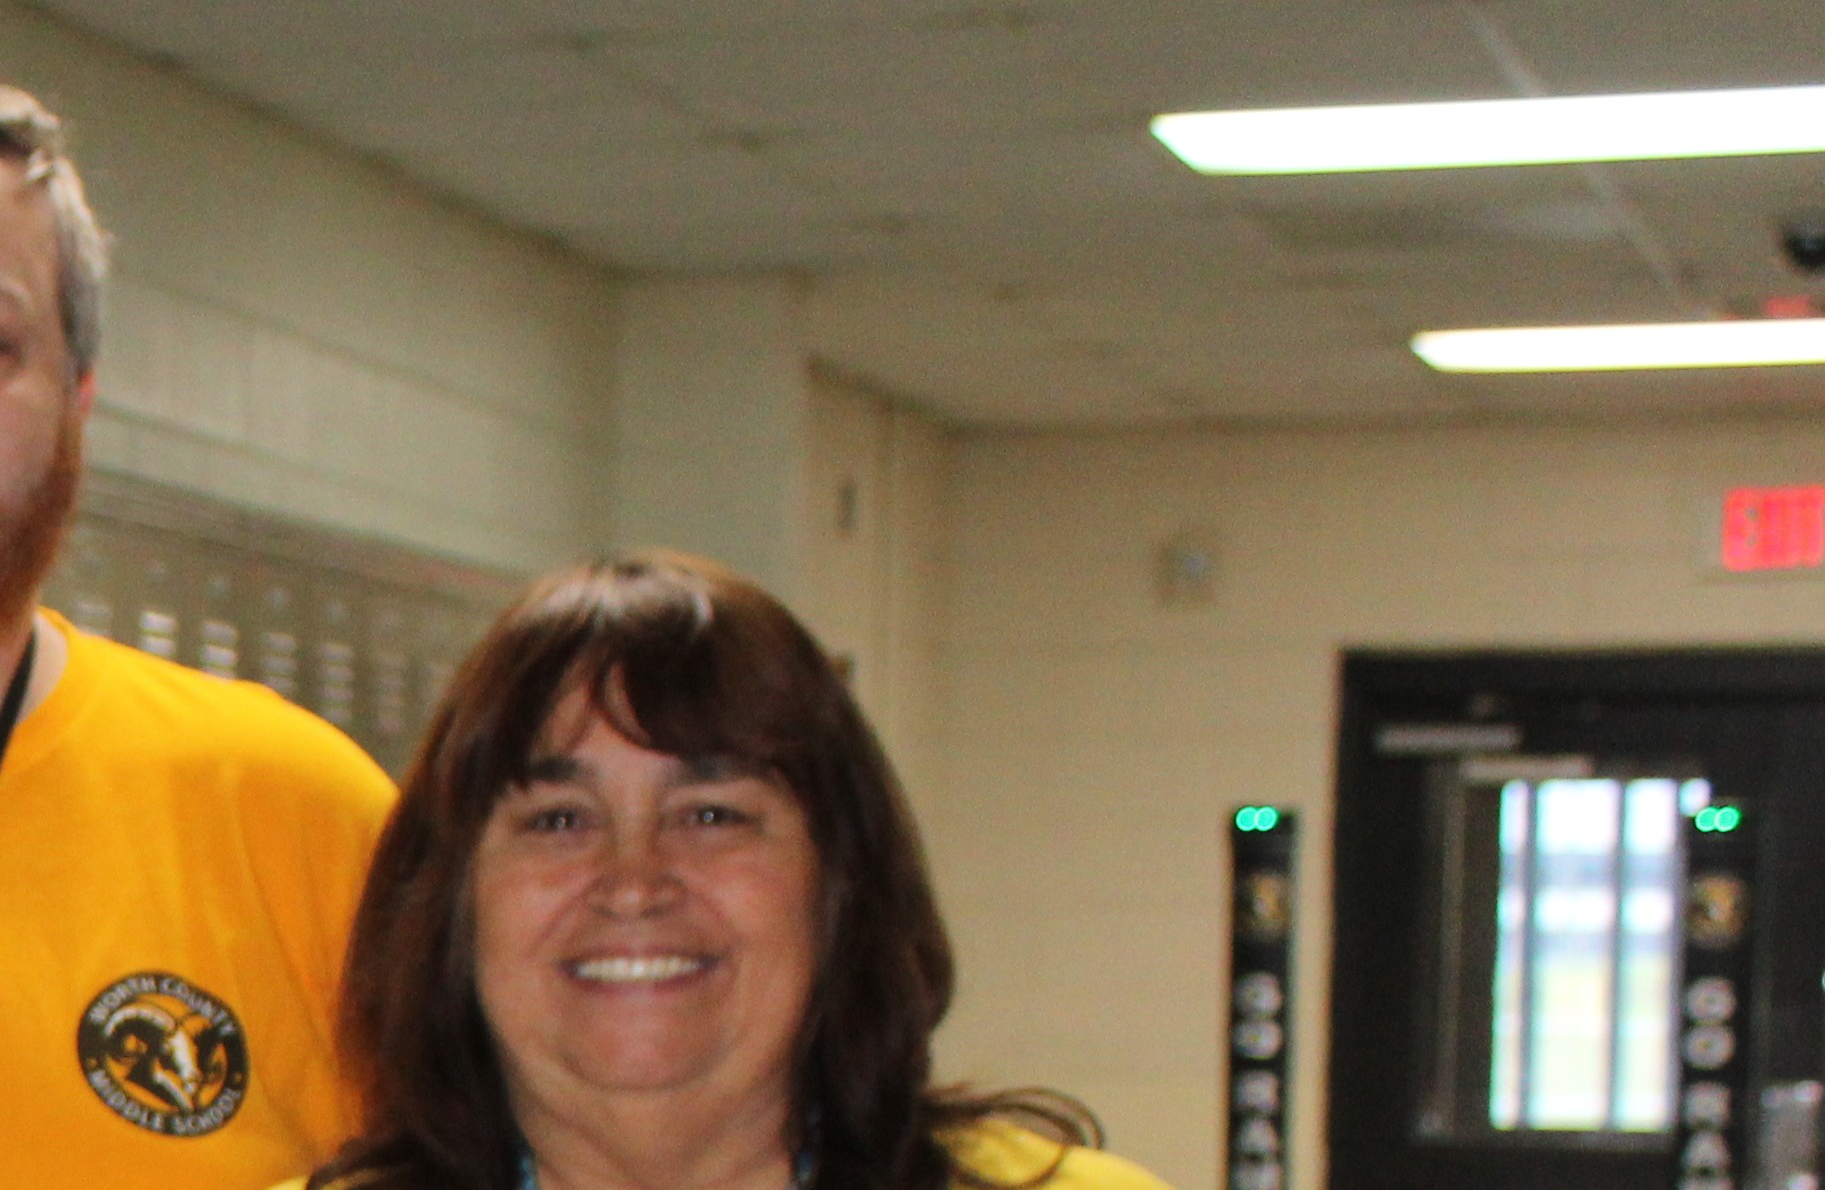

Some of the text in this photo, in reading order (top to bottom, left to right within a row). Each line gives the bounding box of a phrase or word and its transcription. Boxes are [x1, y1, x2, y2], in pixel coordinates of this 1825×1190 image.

[89, 974, 235, 1037] NORTH COUNTY
[88, 1069, 241, 1135] MIDDLE SCHOOL
